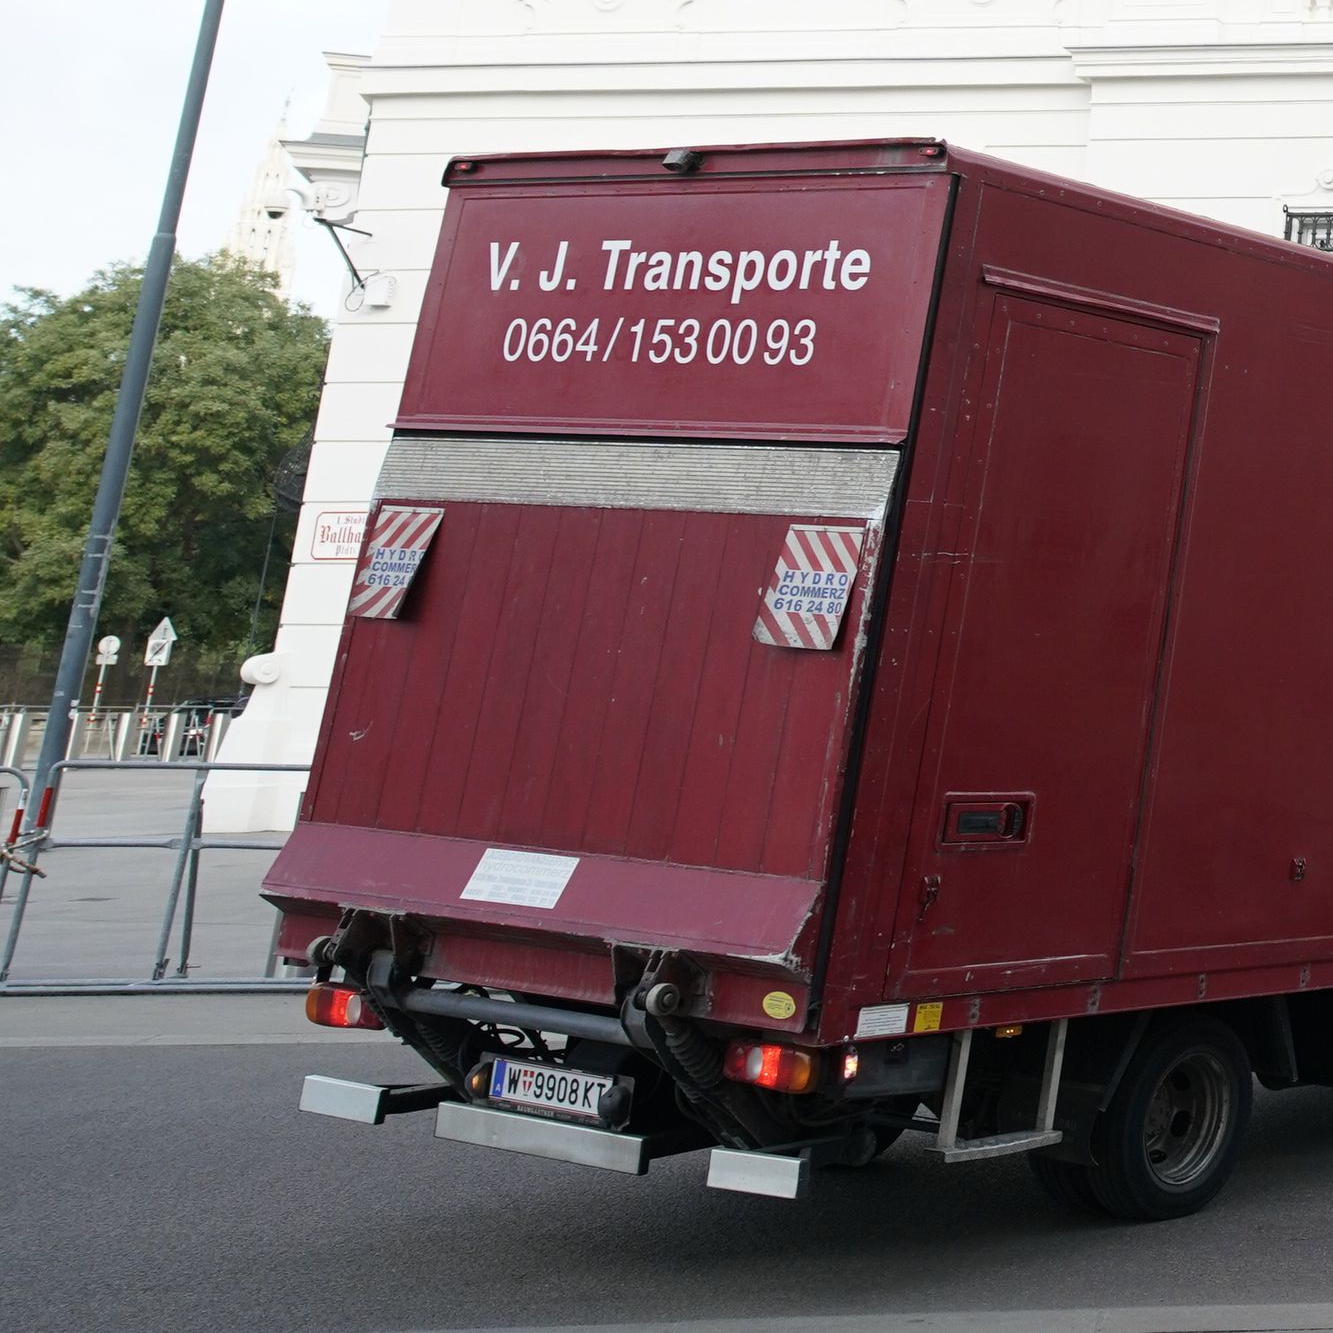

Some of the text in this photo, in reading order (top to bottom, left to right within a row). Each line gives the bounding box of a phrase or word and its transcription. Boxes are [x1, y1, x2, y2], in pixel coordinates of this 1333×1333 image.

[488, 239, 872, 305] V. J. Transporte
[319, 524, 362, 544] Ballha
[371, 561, 417, 574] COMMER
[367, 573, 391, 587] 616
[782, 570, 849, 587] HYDRO
[778, 584, 846, 600] COMMERZ
[773, 597, 842, 615] 616 24 80
